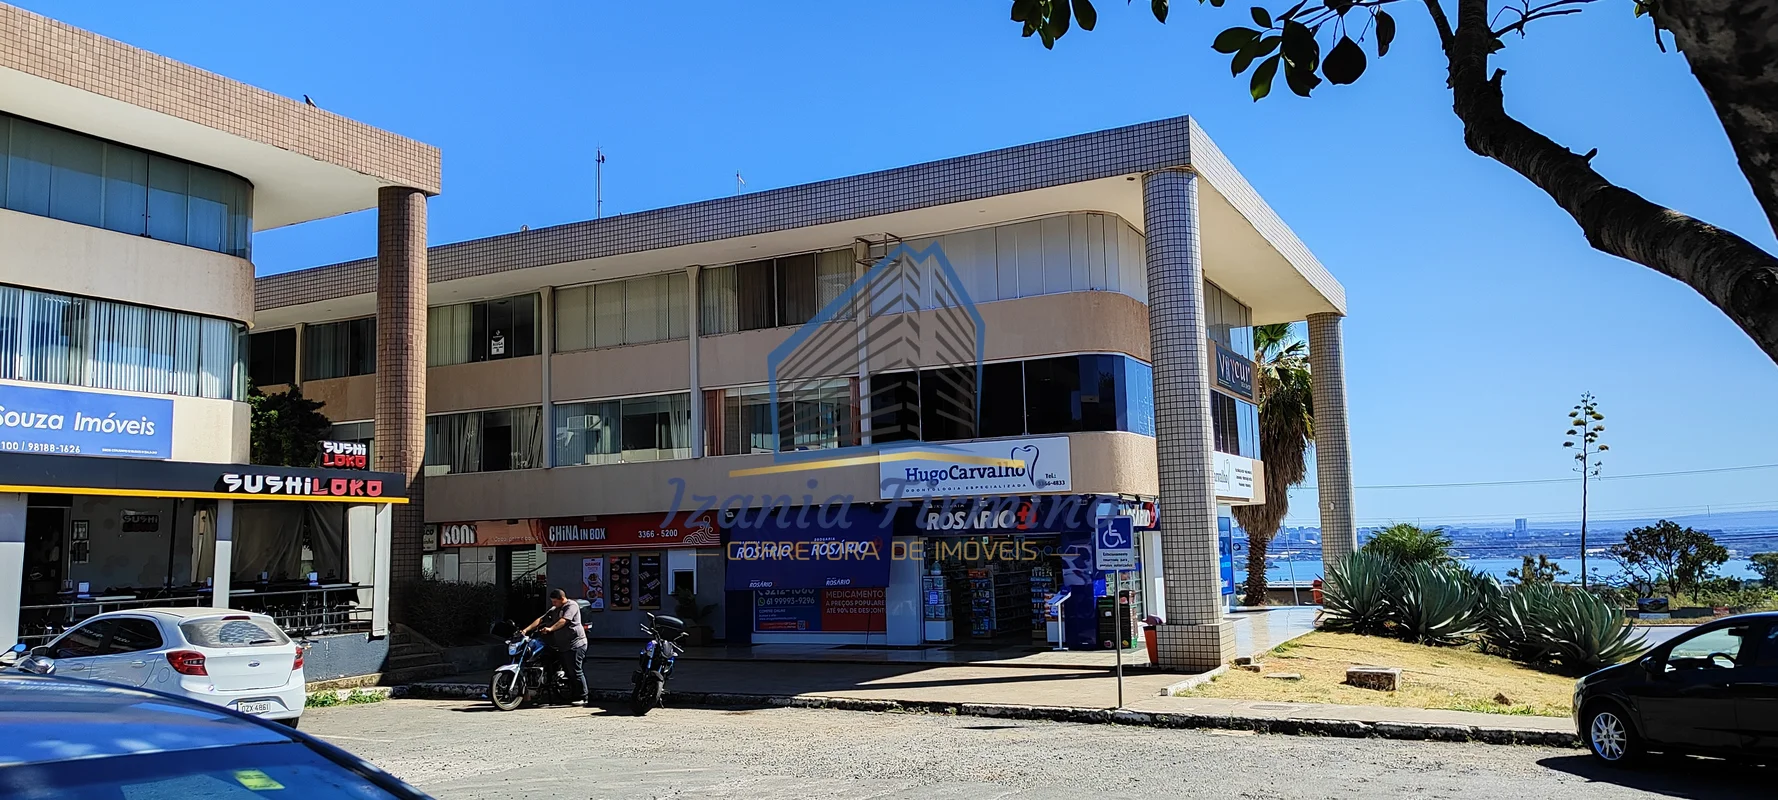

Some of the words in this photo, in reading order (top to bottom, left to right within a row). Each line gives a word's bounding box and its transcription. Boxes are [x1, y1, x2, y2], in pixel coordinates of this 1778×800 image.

[0, 405, 64, 430] Souza
[74, 412, 156, 436] Imóveis
[28, 442, 80, 453] 98188-1626
[323, 454, 366, 468] LOKO
[905, 462, 1025, 486] HugoCarvalho
[580, 528, 588, 541] IN
[590, 528, 606, 540] BOX
[638, 530, 655, 538] 3366
[661, 528, 678, 538] 5200
[736, 543, 791, 559] ROSÁRIO
[810, 540, 869, 556] ROSÁRIO
[749, 580, 772, 588] ROSÁRIO
[826, 578, 850, 586] ROSÁRIO
